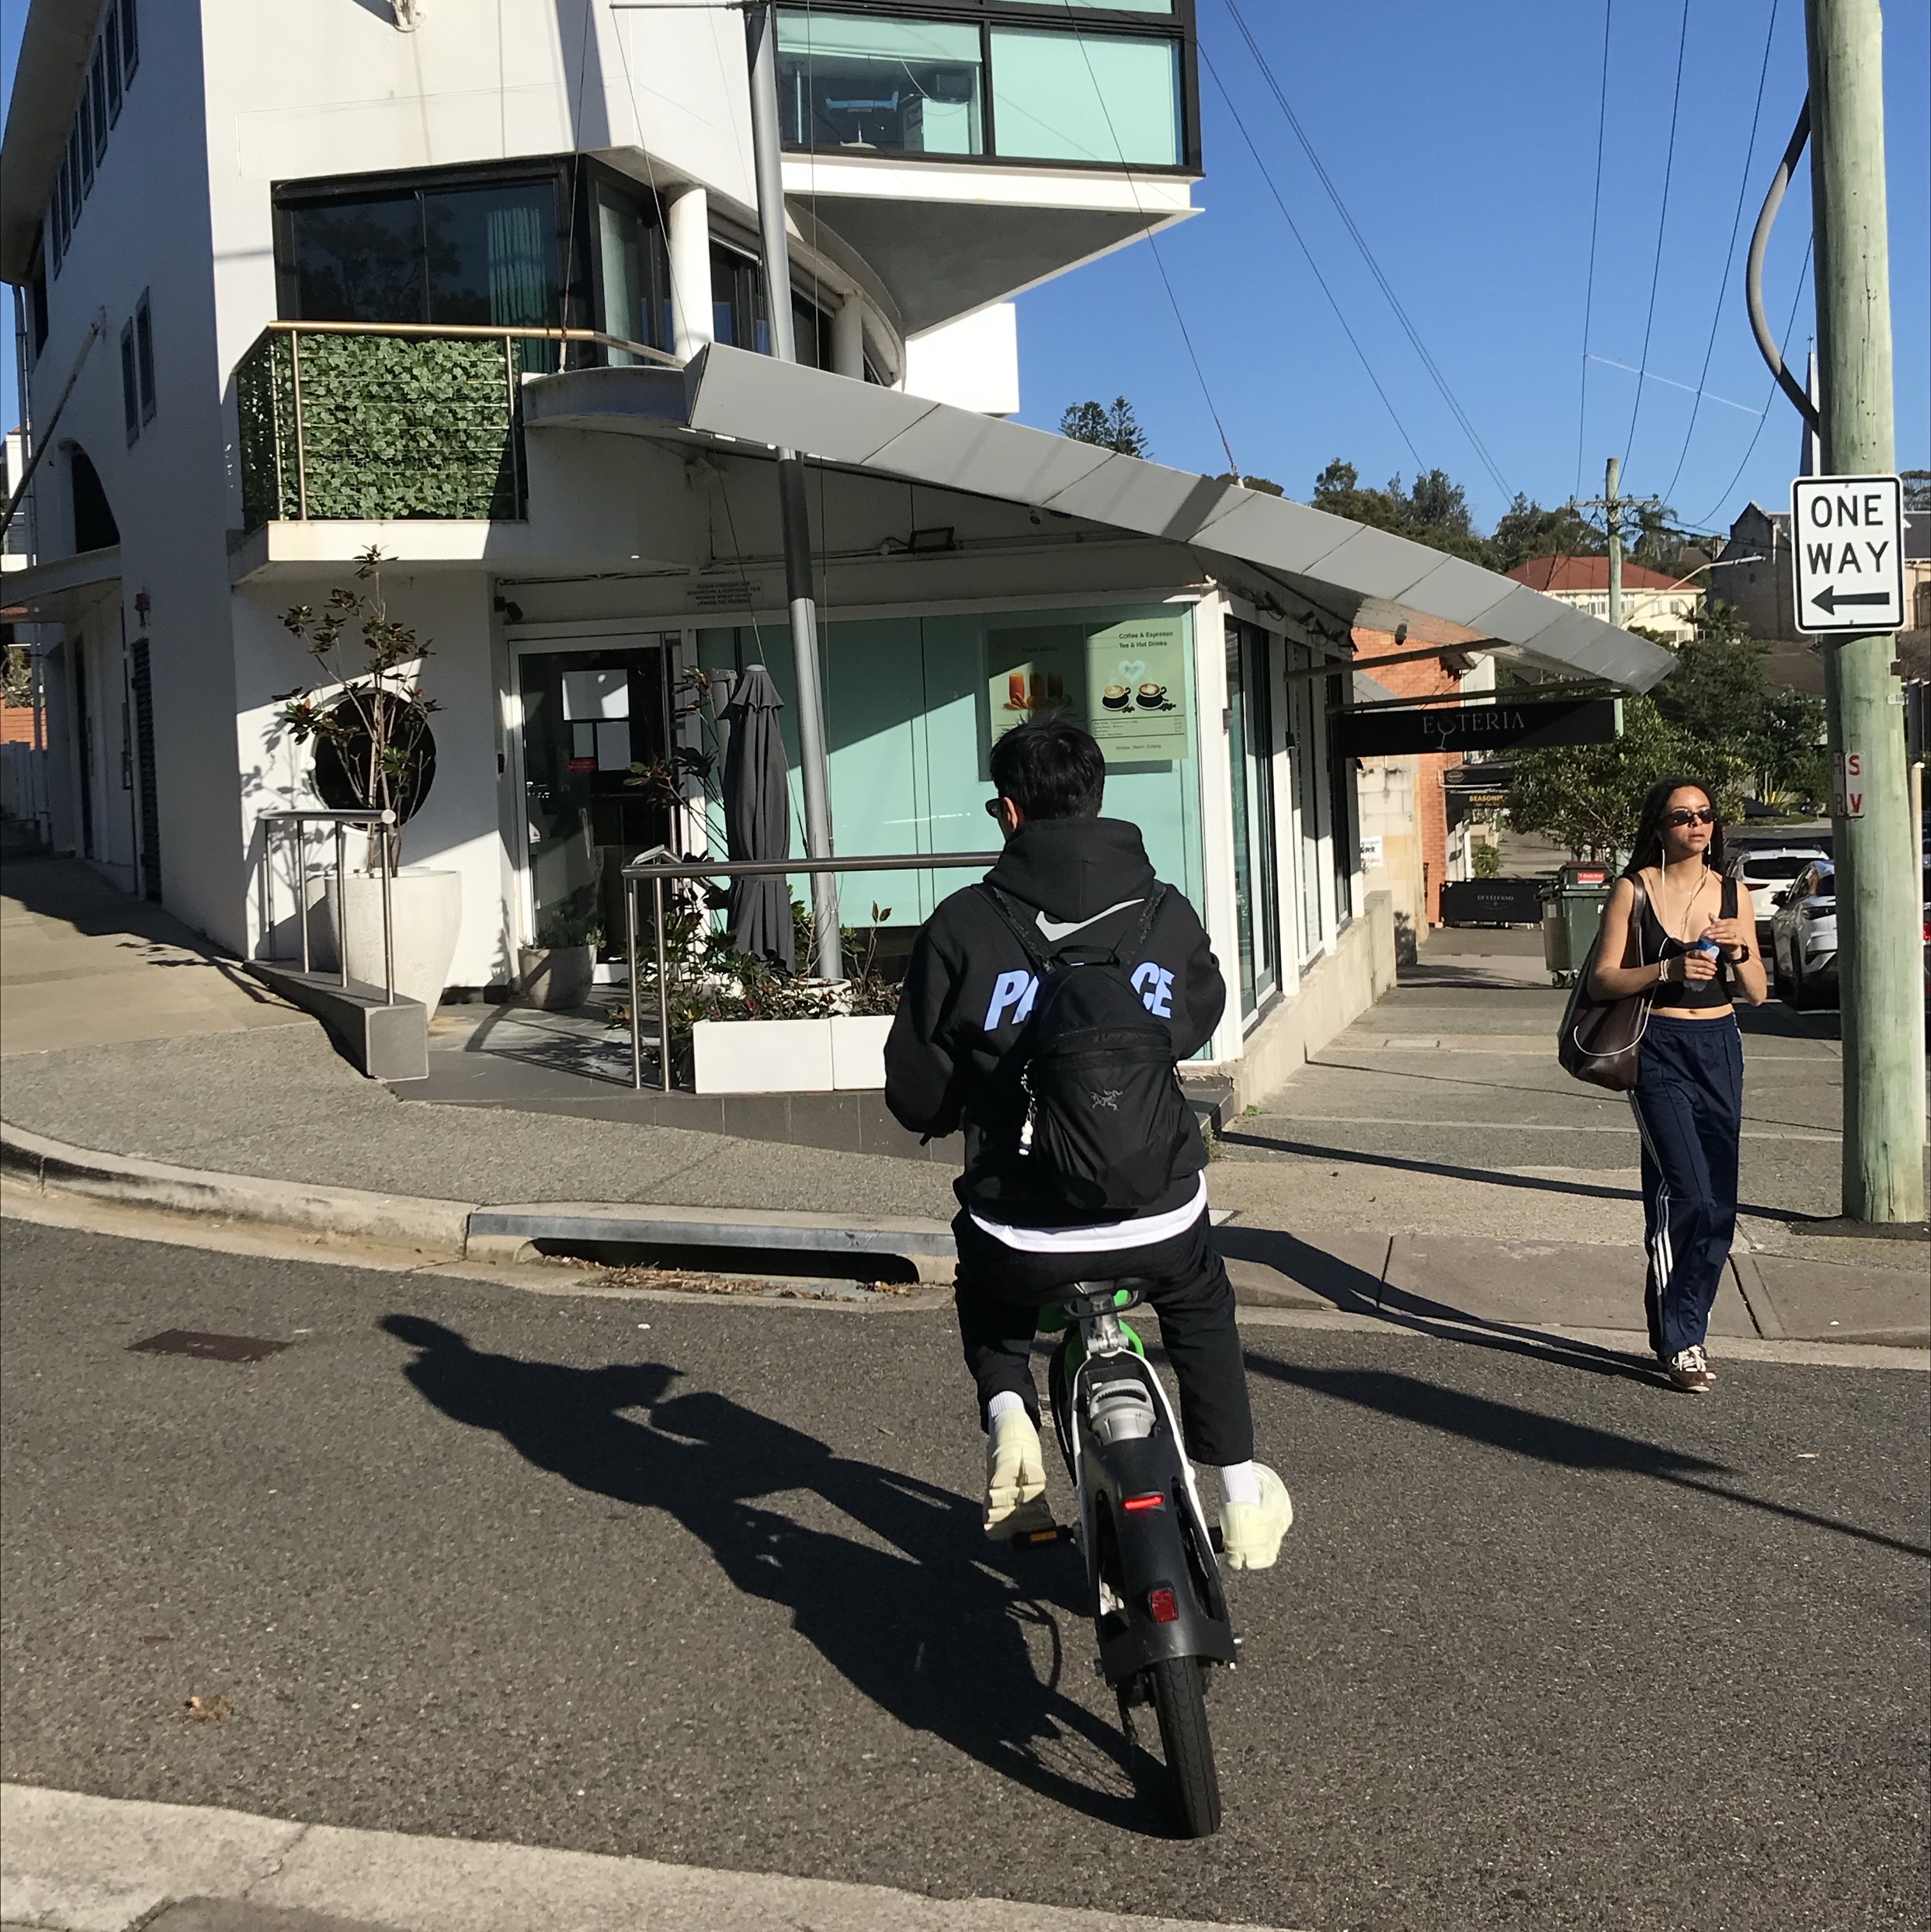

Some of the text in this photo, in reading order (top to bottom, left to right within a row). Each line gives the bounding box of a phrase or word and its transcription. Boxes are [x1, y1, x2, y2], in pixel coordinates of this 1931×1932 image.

[1810, 494, 1884, 528] ONE
[1806, 540, 1889, 575] WAY
[1849, 754, 1861, 776] S
[1849, 793, 1863, 813] V
